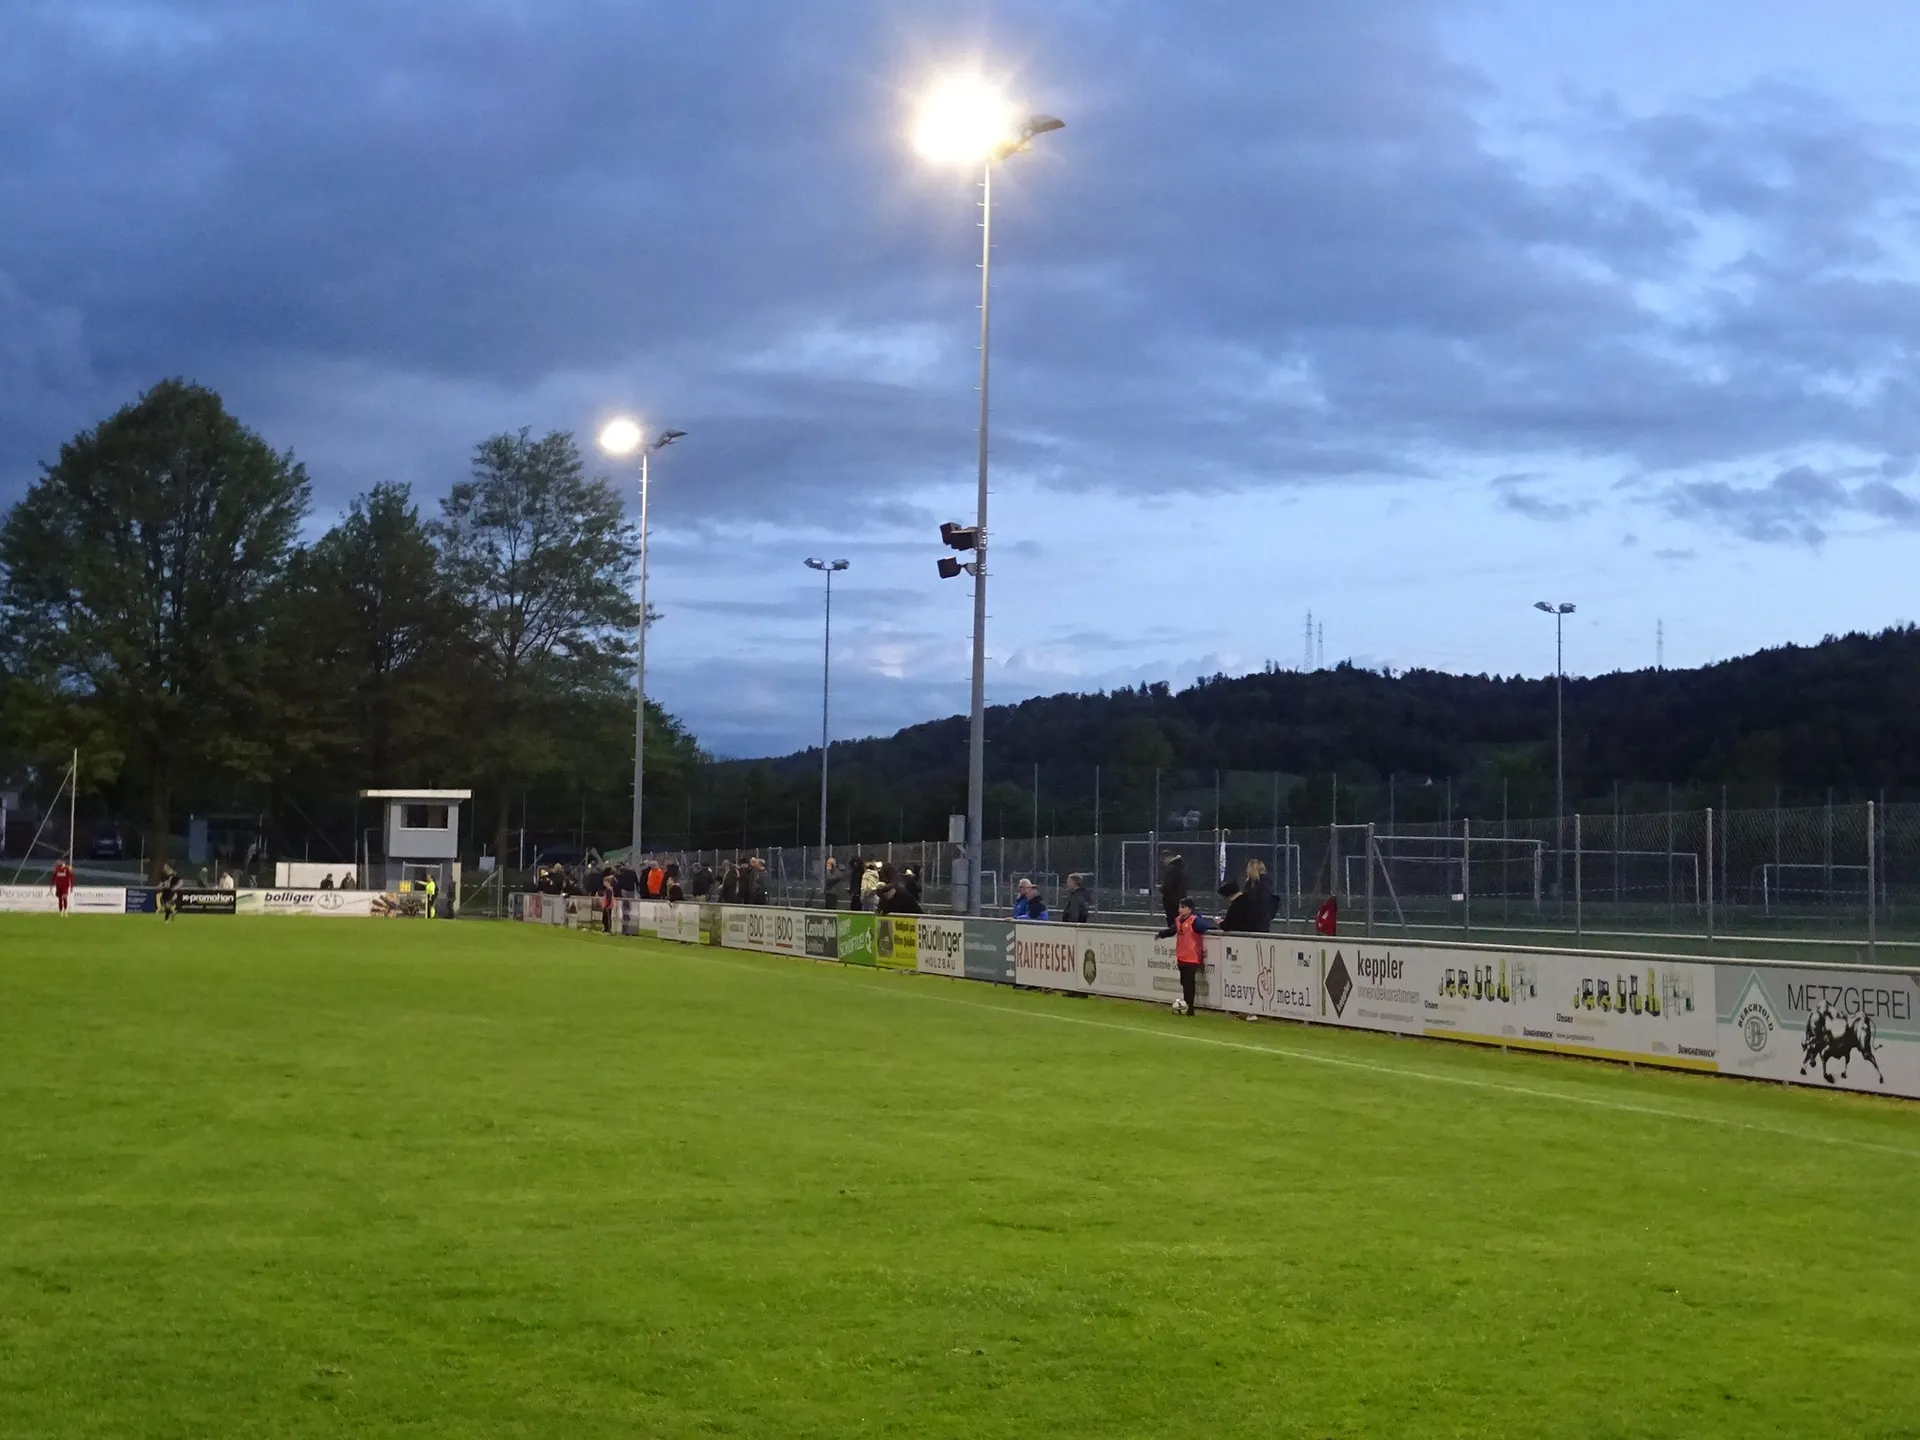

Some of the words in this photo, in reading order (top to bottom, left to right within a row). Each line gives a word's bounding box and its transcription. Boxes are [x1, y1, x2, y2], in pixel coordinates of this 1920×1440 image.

[264, 892, 316, 904] bolliger
[776, 916, 793, 941] BDO
[921, 924, 962, 957] Rüdlinger
[924, 955, 956, 970] HOLZBAU
[1016, 940, 1075, 973] RAIFFEISEN
[1357, 949, 1404, 985] keppler
[1224, 978, 1256, 1006] heavy
[1276, 987, 1312, 1007] metal
[1787, 983, 1912, 1020] METZGEREI
